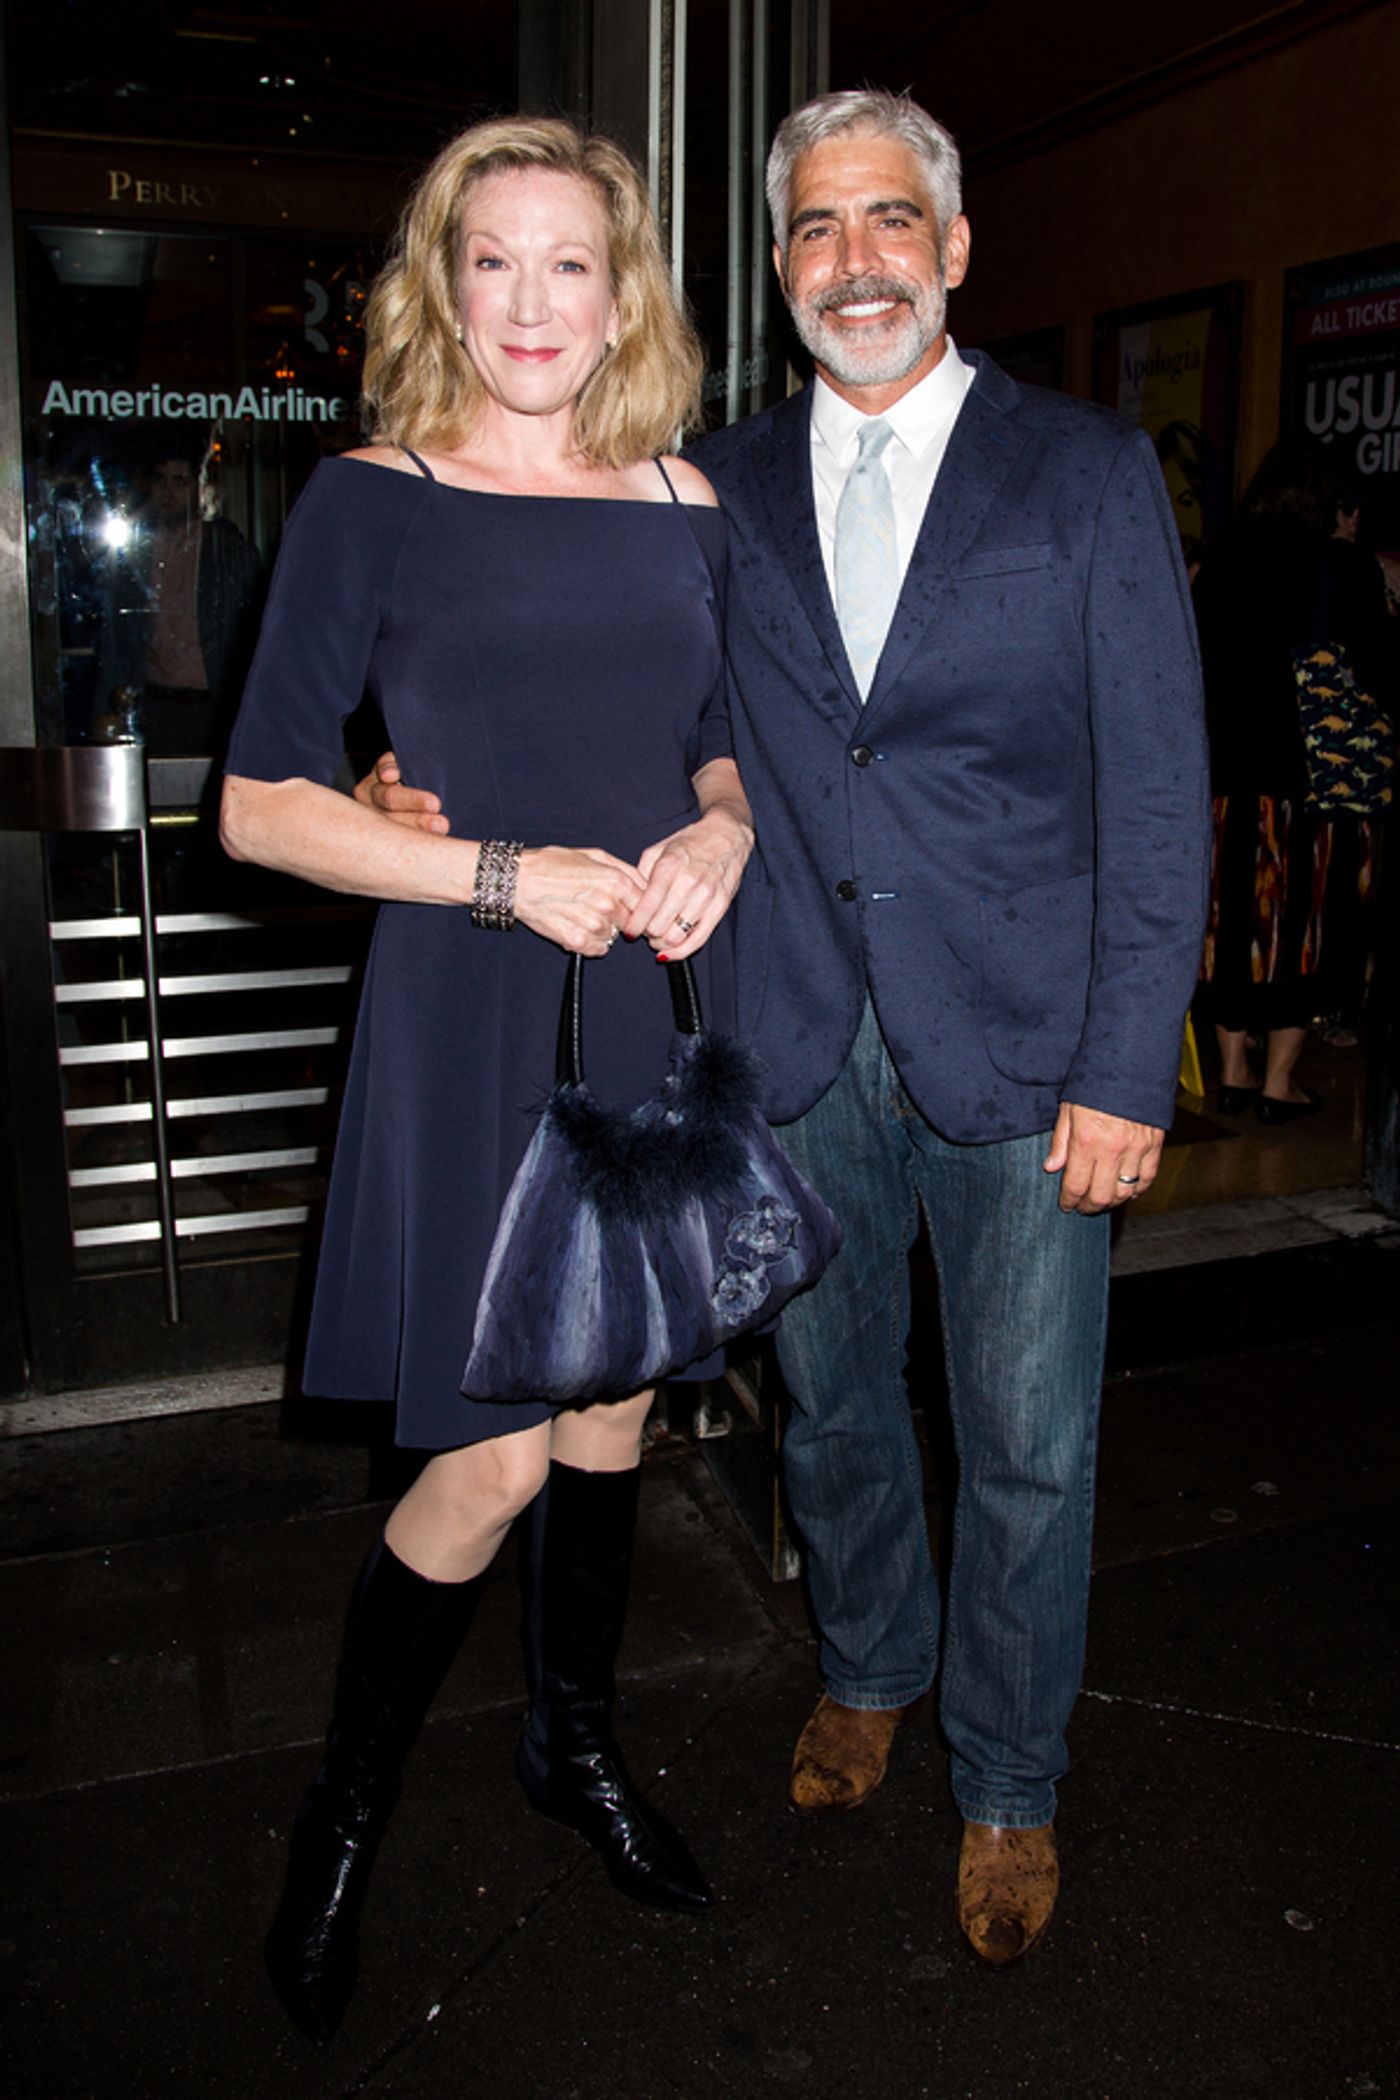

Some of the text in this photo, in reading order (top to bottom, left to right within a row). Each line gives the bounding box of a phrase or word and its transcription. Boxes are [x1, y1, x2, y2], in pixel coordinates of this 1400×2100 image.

[107, 170, 223, 207] PERRY
[1353, 278, 1366, 293] AT
[1311, 309, 1341, 336] ALL
[1121, 339, 1200, 389] Apologia
